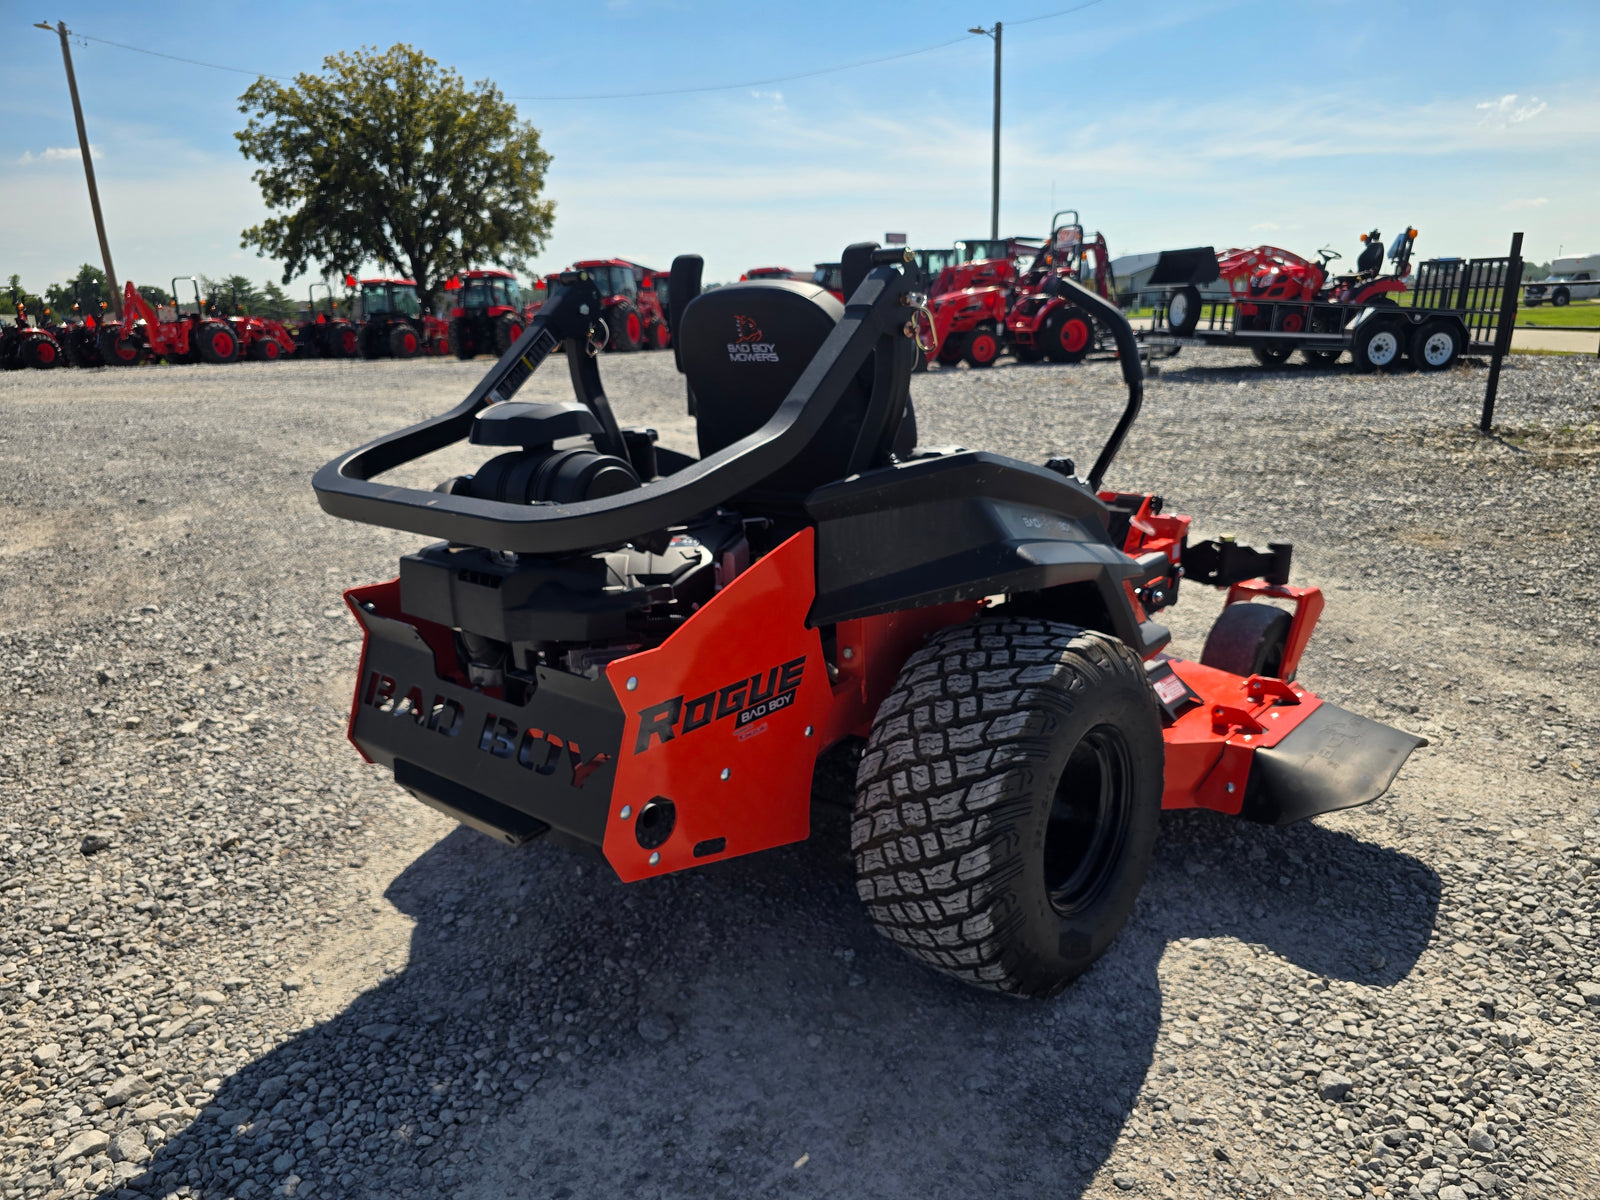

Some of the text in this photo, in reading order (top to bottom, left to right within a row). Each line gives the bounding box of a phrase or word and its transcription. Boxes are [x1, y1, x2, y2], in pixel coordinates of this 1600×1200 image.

[727, 344, 775, 352] BAD BOY
[729, 353, 779, 362] MOWERS
[634, 655, 807, 756] ROGUE
[741, 693, 793, 723] BAD BOY
[365, 671, 612, 789] BAD BOY
